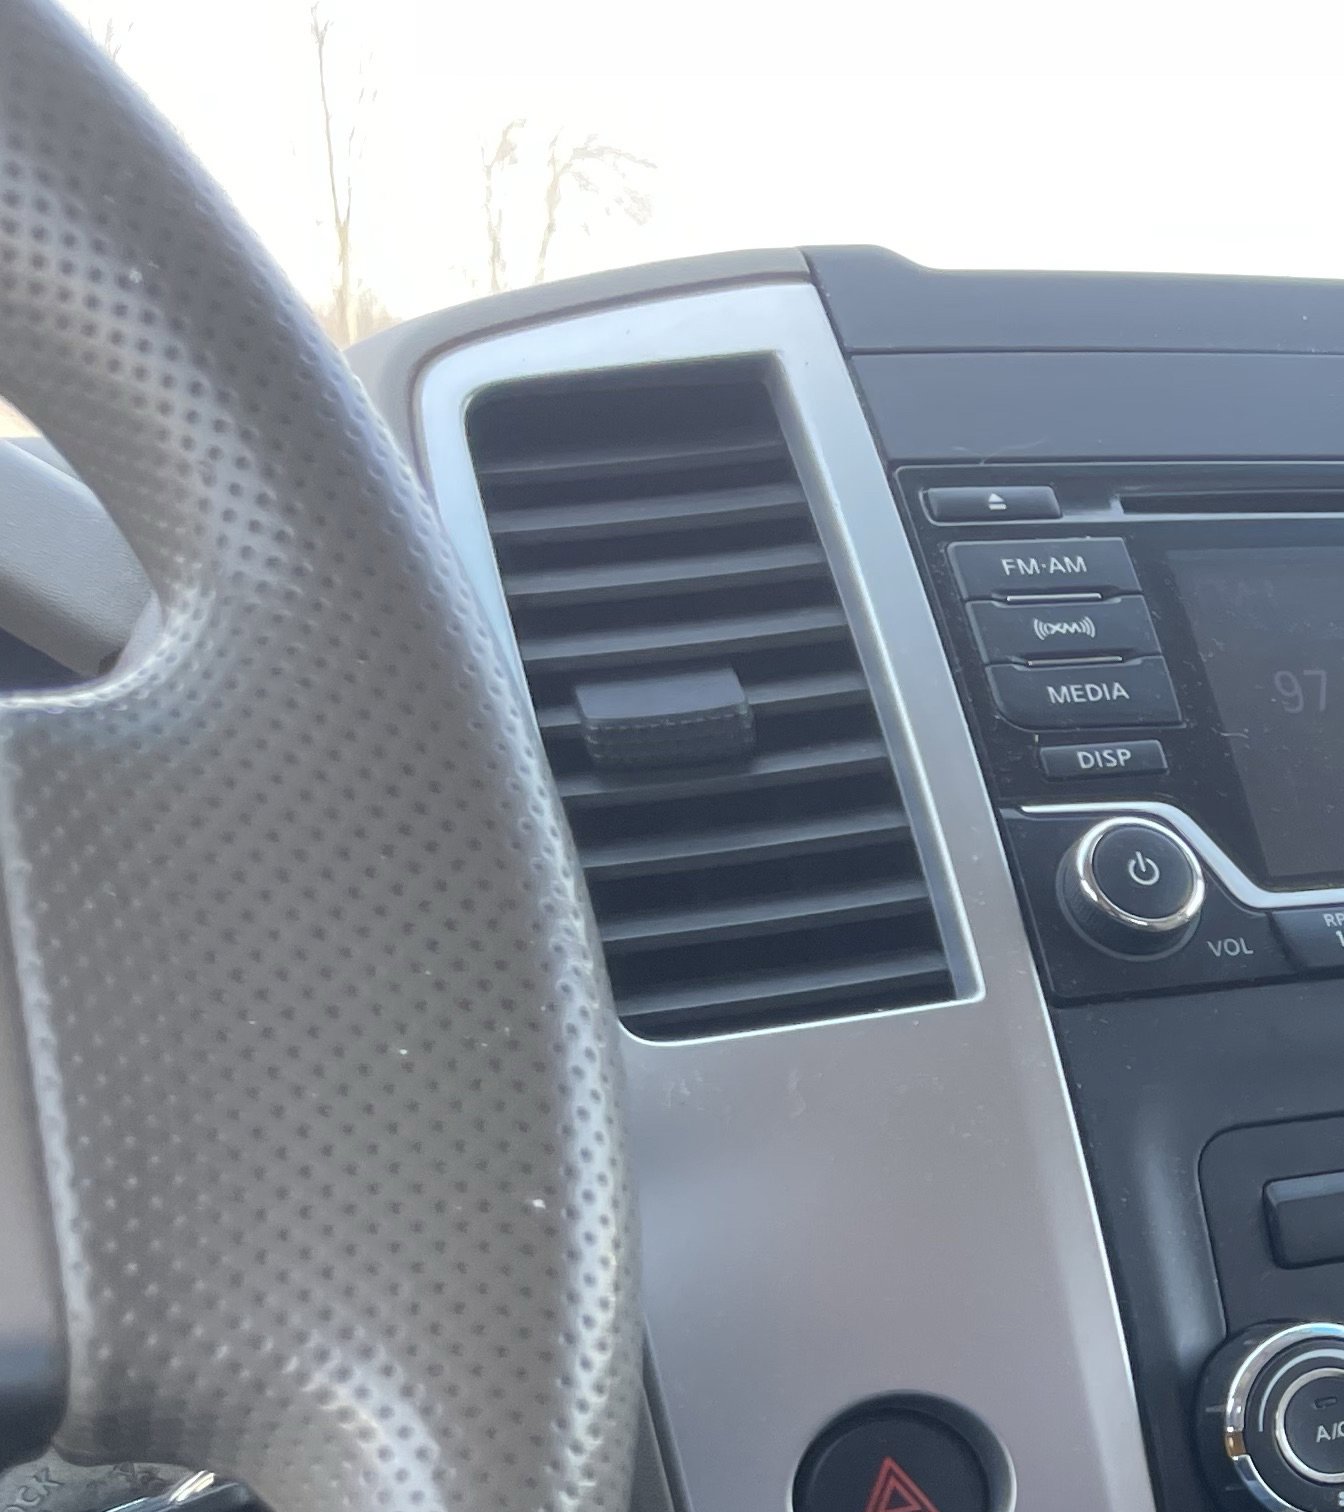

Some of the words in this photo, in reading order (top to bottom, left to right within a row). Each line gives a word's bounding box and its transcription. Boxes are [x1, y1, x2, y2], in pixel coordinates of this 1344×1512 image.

[1047, 682, 1129, 704] MEDIA
[1077, 748, 1132, 768] DISP
[1207, 938, 1254, 958] VOL
